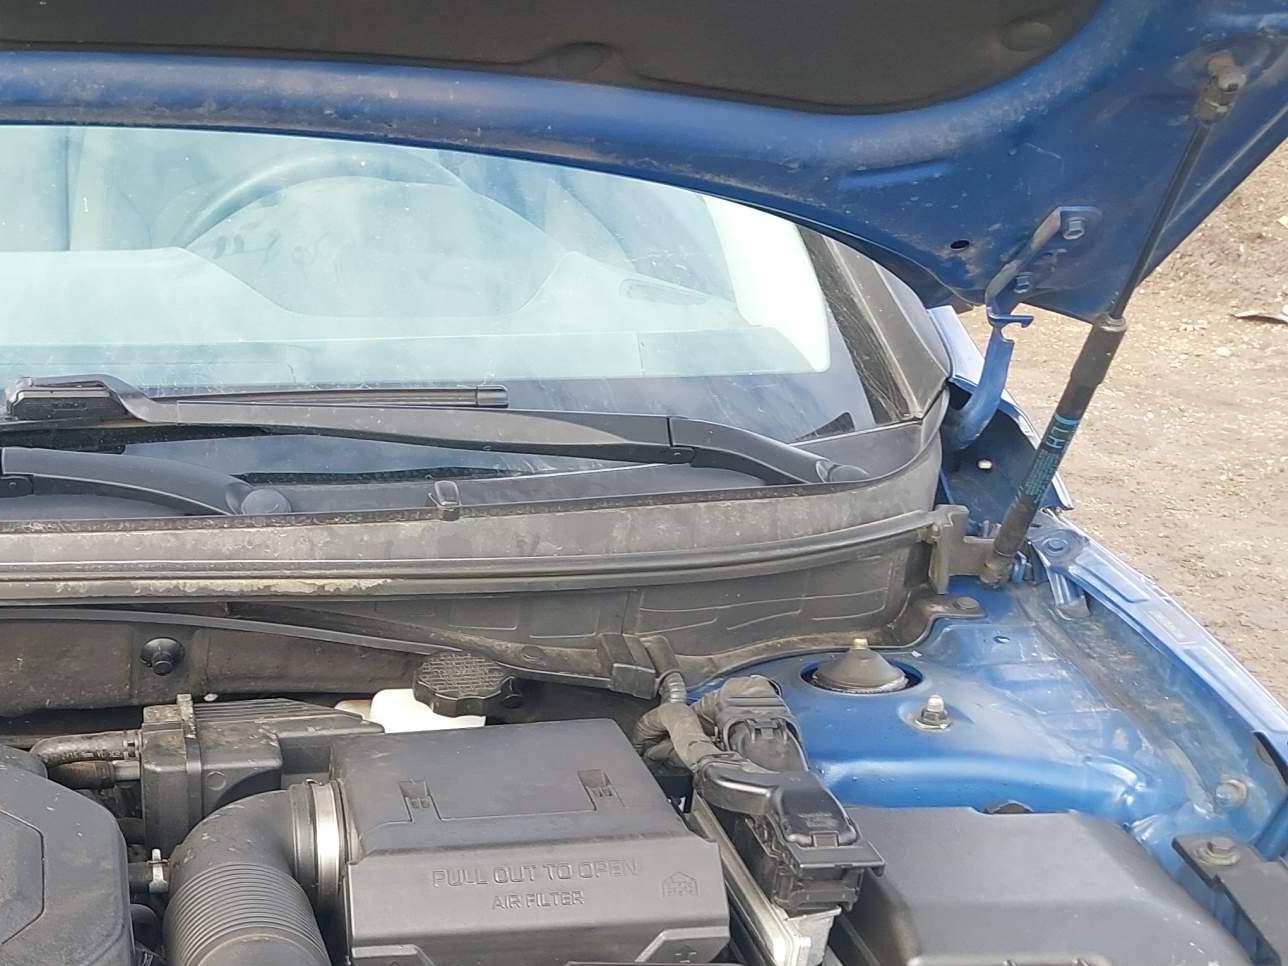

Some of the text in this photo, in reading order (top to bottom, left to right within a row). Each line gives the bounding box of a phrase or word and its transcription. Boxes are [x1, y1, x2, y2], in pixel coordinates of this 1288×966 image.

[431, 858, 640, 888] PULL OUT TO OPEN
[492, 891, 584, 910] AIR FILTER
